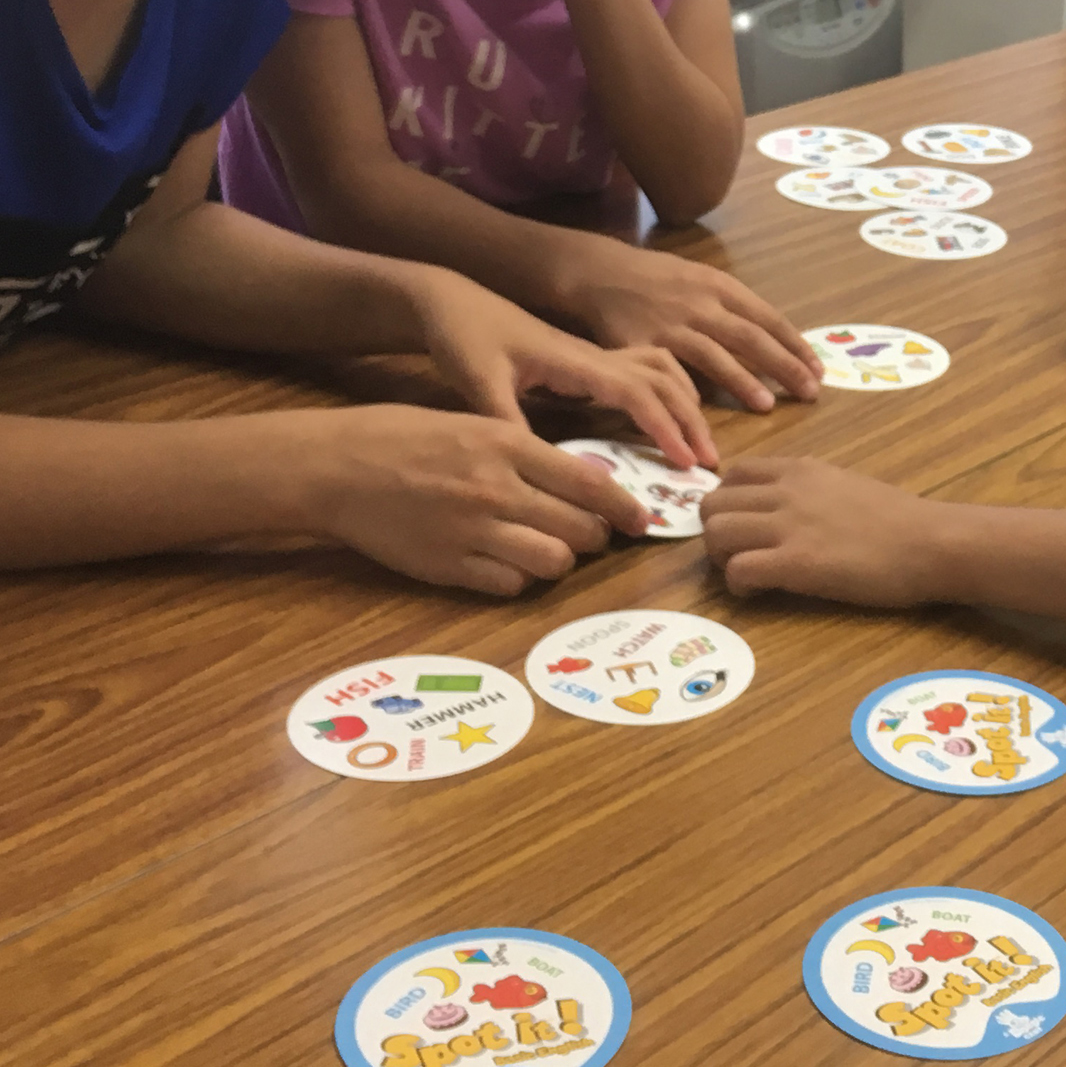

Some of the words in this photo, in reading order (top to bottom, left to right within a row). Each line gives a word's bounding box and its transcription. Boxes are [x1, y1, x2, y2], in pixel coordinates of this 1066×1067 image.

[566, 620, 631, 651] SPOON
[612, 622, 667, 658] WATCH
[325, 670, 396, 706] FISH
[406, 691, 507, 731] HAMMER
[406, 737, 427, 772] TRAIN
[931, 910, 971, 924] BOAT
[526, 957, 565, 979] BOAT
[852, 961, 874, 994] BIRD
[385, 987, 426, 1019] BIRD
[875, 972, 983, 1036] Spot
